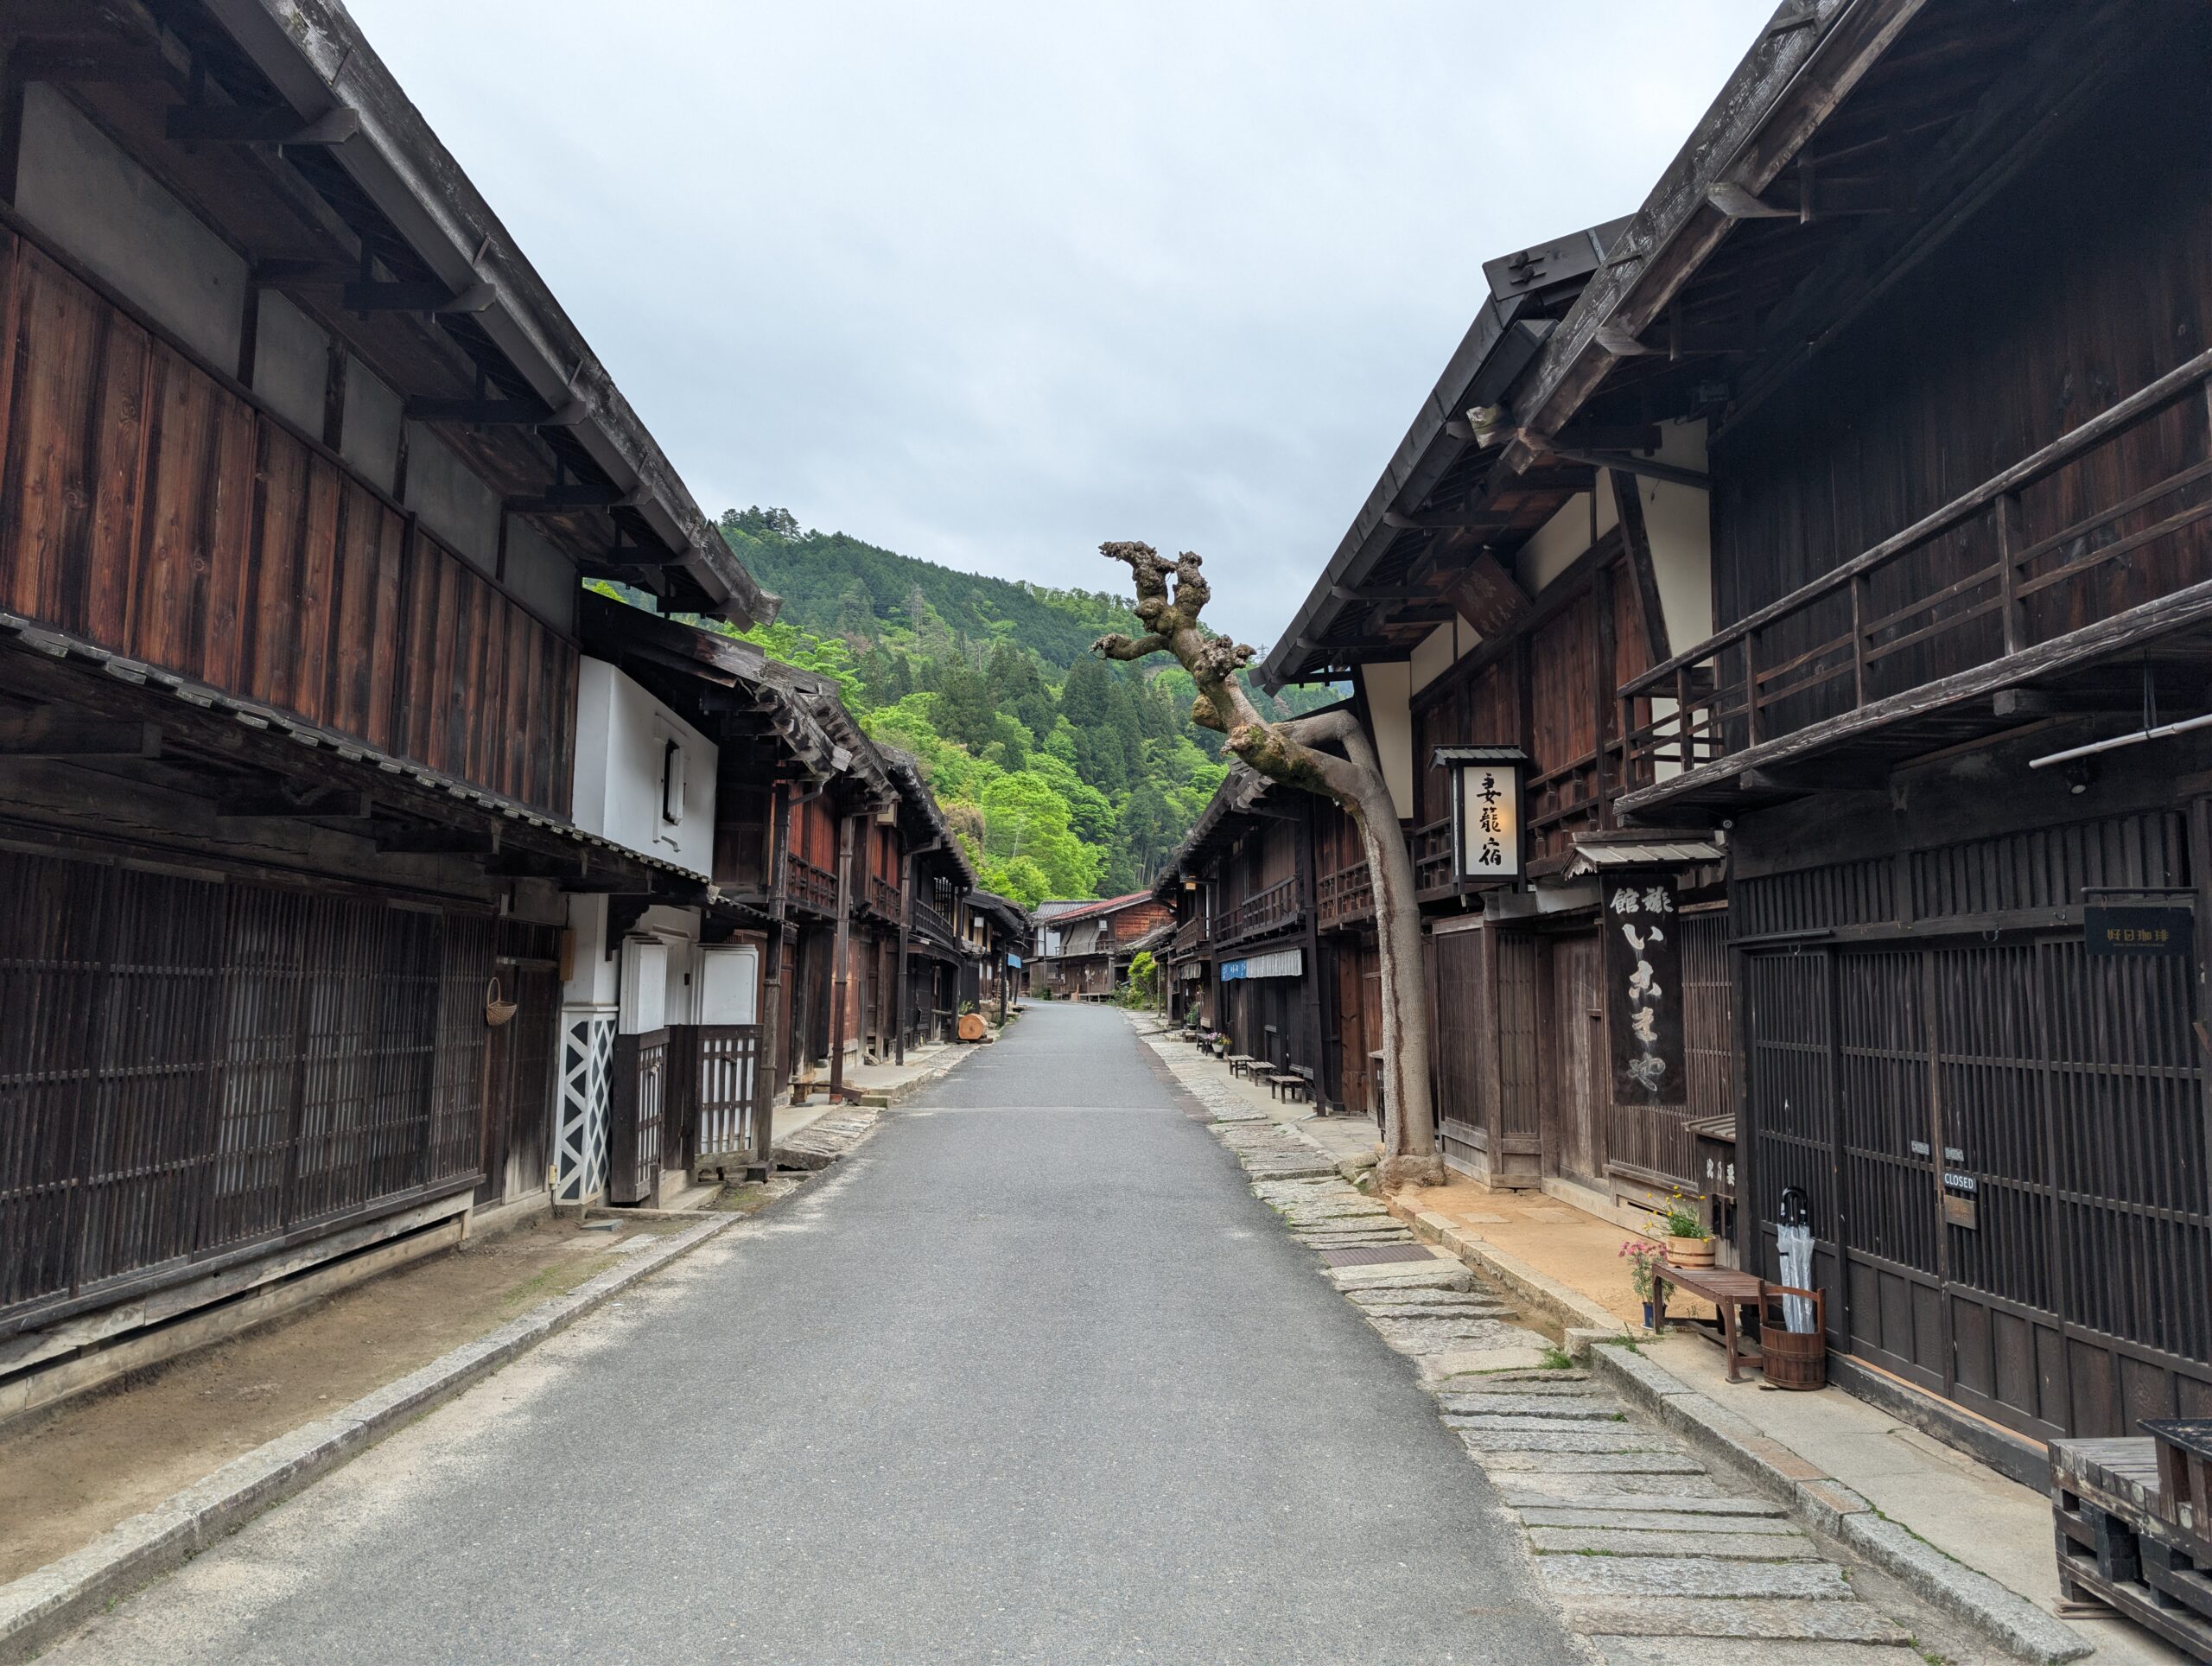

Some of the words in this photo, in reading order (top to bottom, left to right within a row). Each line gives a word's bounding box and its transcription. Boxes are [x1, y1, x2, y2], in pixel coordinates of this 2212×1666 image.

[1476, 773, 1502, 866] 妻籠宿
[2107, 929, 2170, 942] 好日珈琲
[1944, 1173, 1974, 1189] CLOSED
